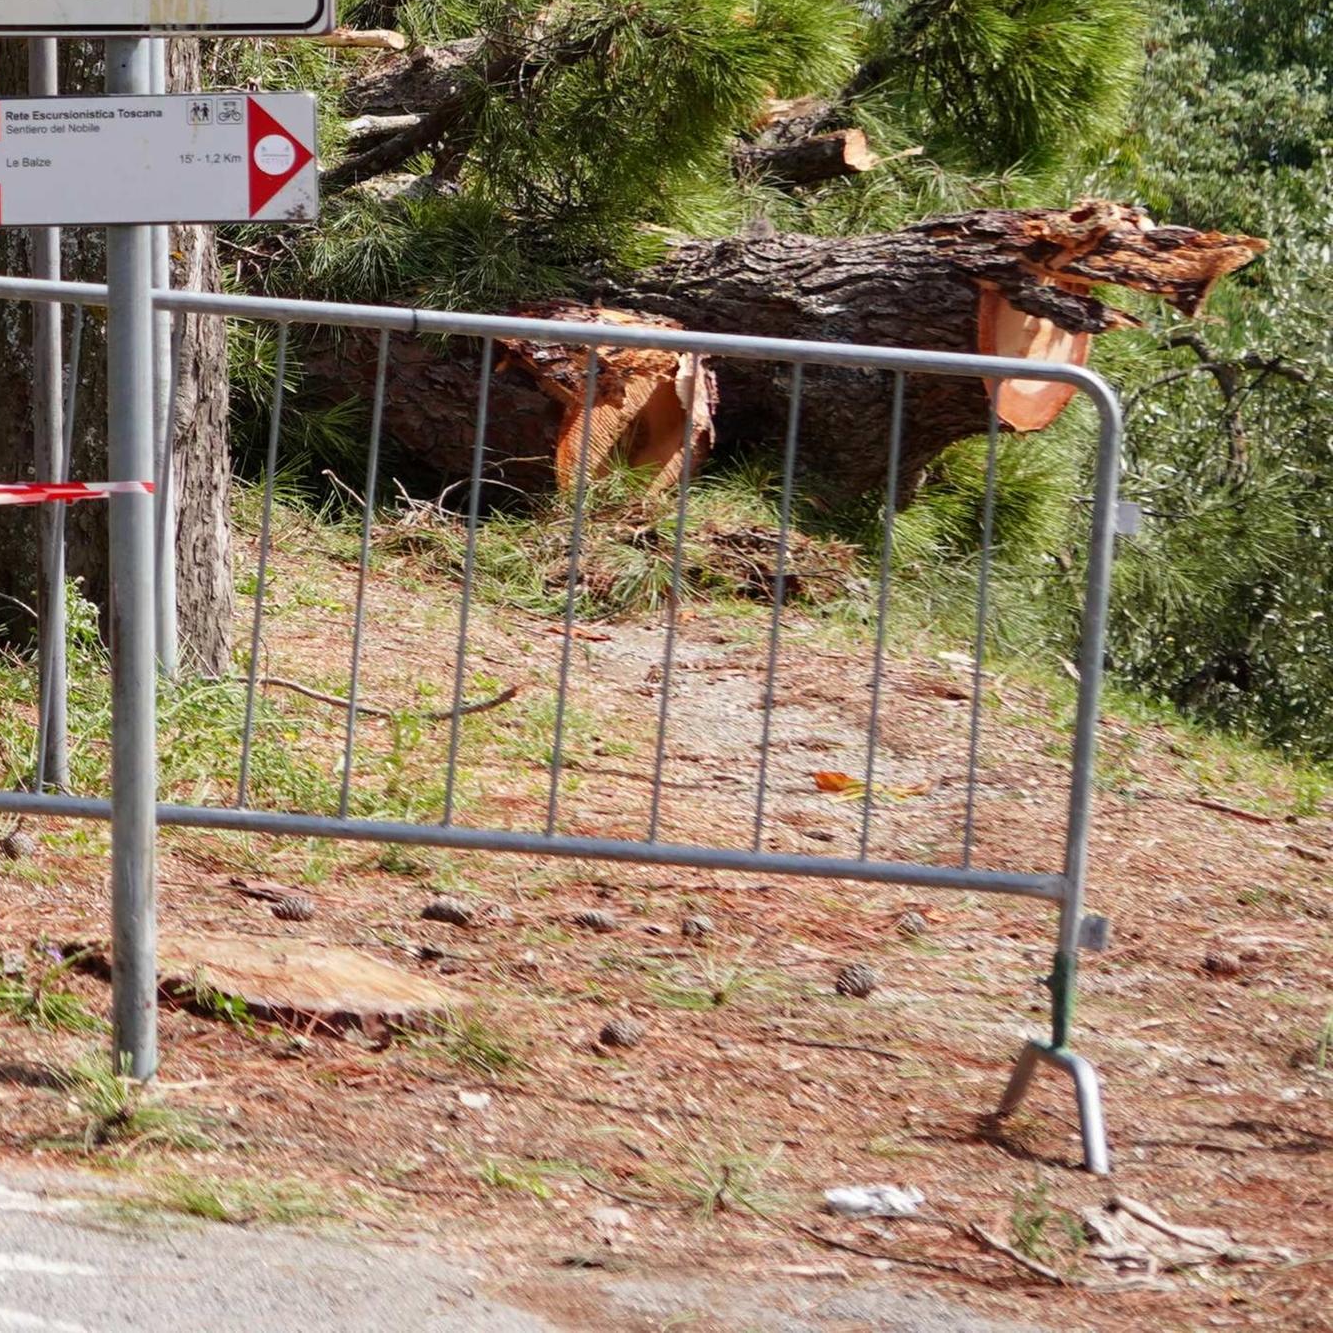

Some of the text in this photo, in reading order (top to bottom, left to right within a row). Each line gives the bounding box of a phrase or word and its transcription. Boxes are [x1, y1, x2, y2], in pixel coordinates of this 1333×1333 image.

[5, 109, 163, 121] Rete Escursionistica Toscana
[6, 123, 101, 135] Sentiero del Nobile
[6, 157, 52, 168] Le Balze
[179, 153, 194, 164] 15'
[205, 154, 222, 165] 1,2
[224, 154, 242, 164] Km
